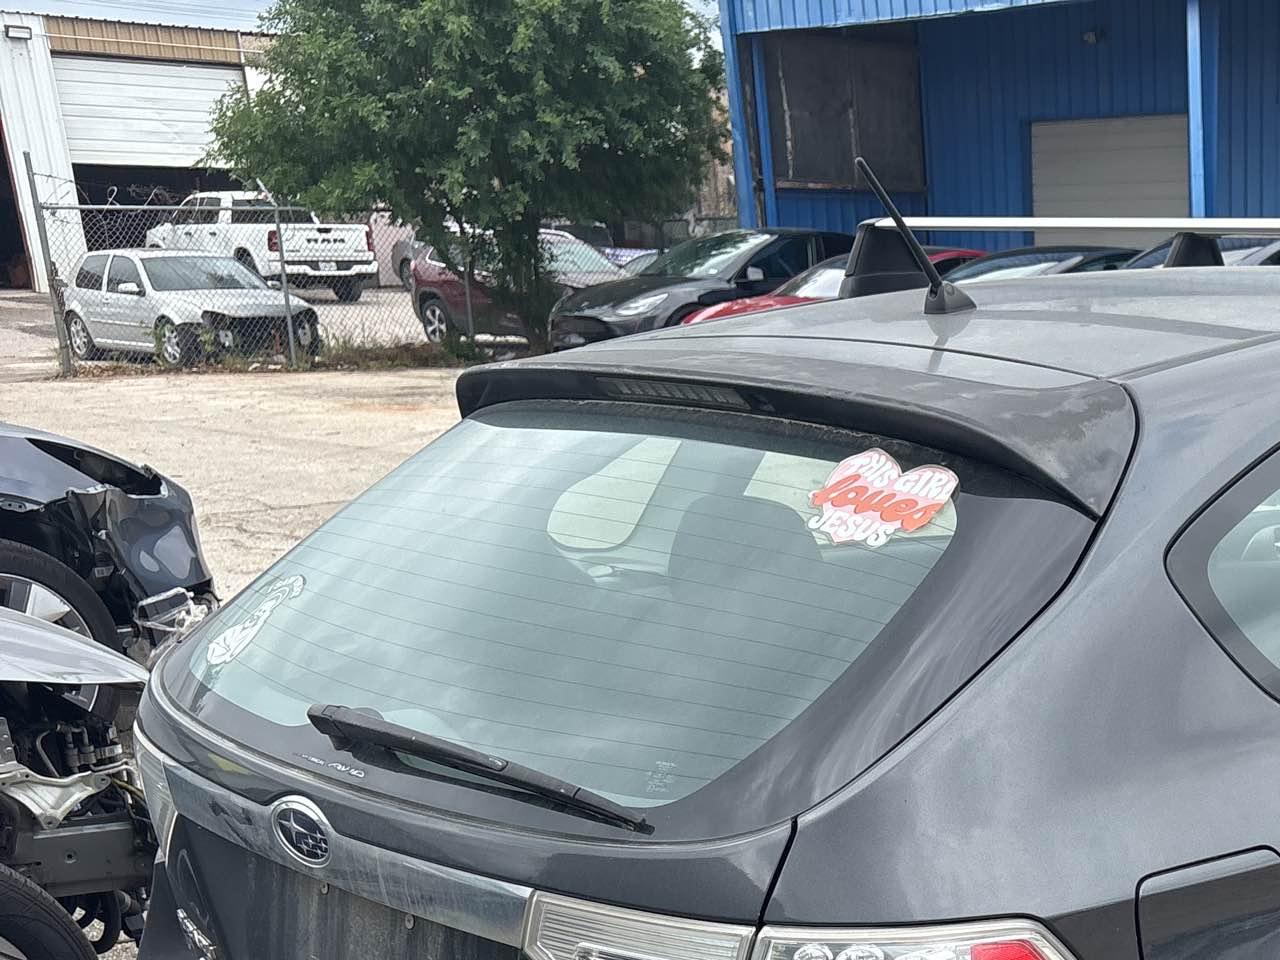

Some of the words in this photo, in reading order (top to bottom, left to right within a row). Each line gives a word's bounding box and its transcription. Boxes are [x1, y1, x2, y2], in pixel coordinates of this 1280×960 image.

[843, 453, 893, 488] THIS
[894, 472, 953, 498] GIRL
[809, 509, 895, 547] JESUS
